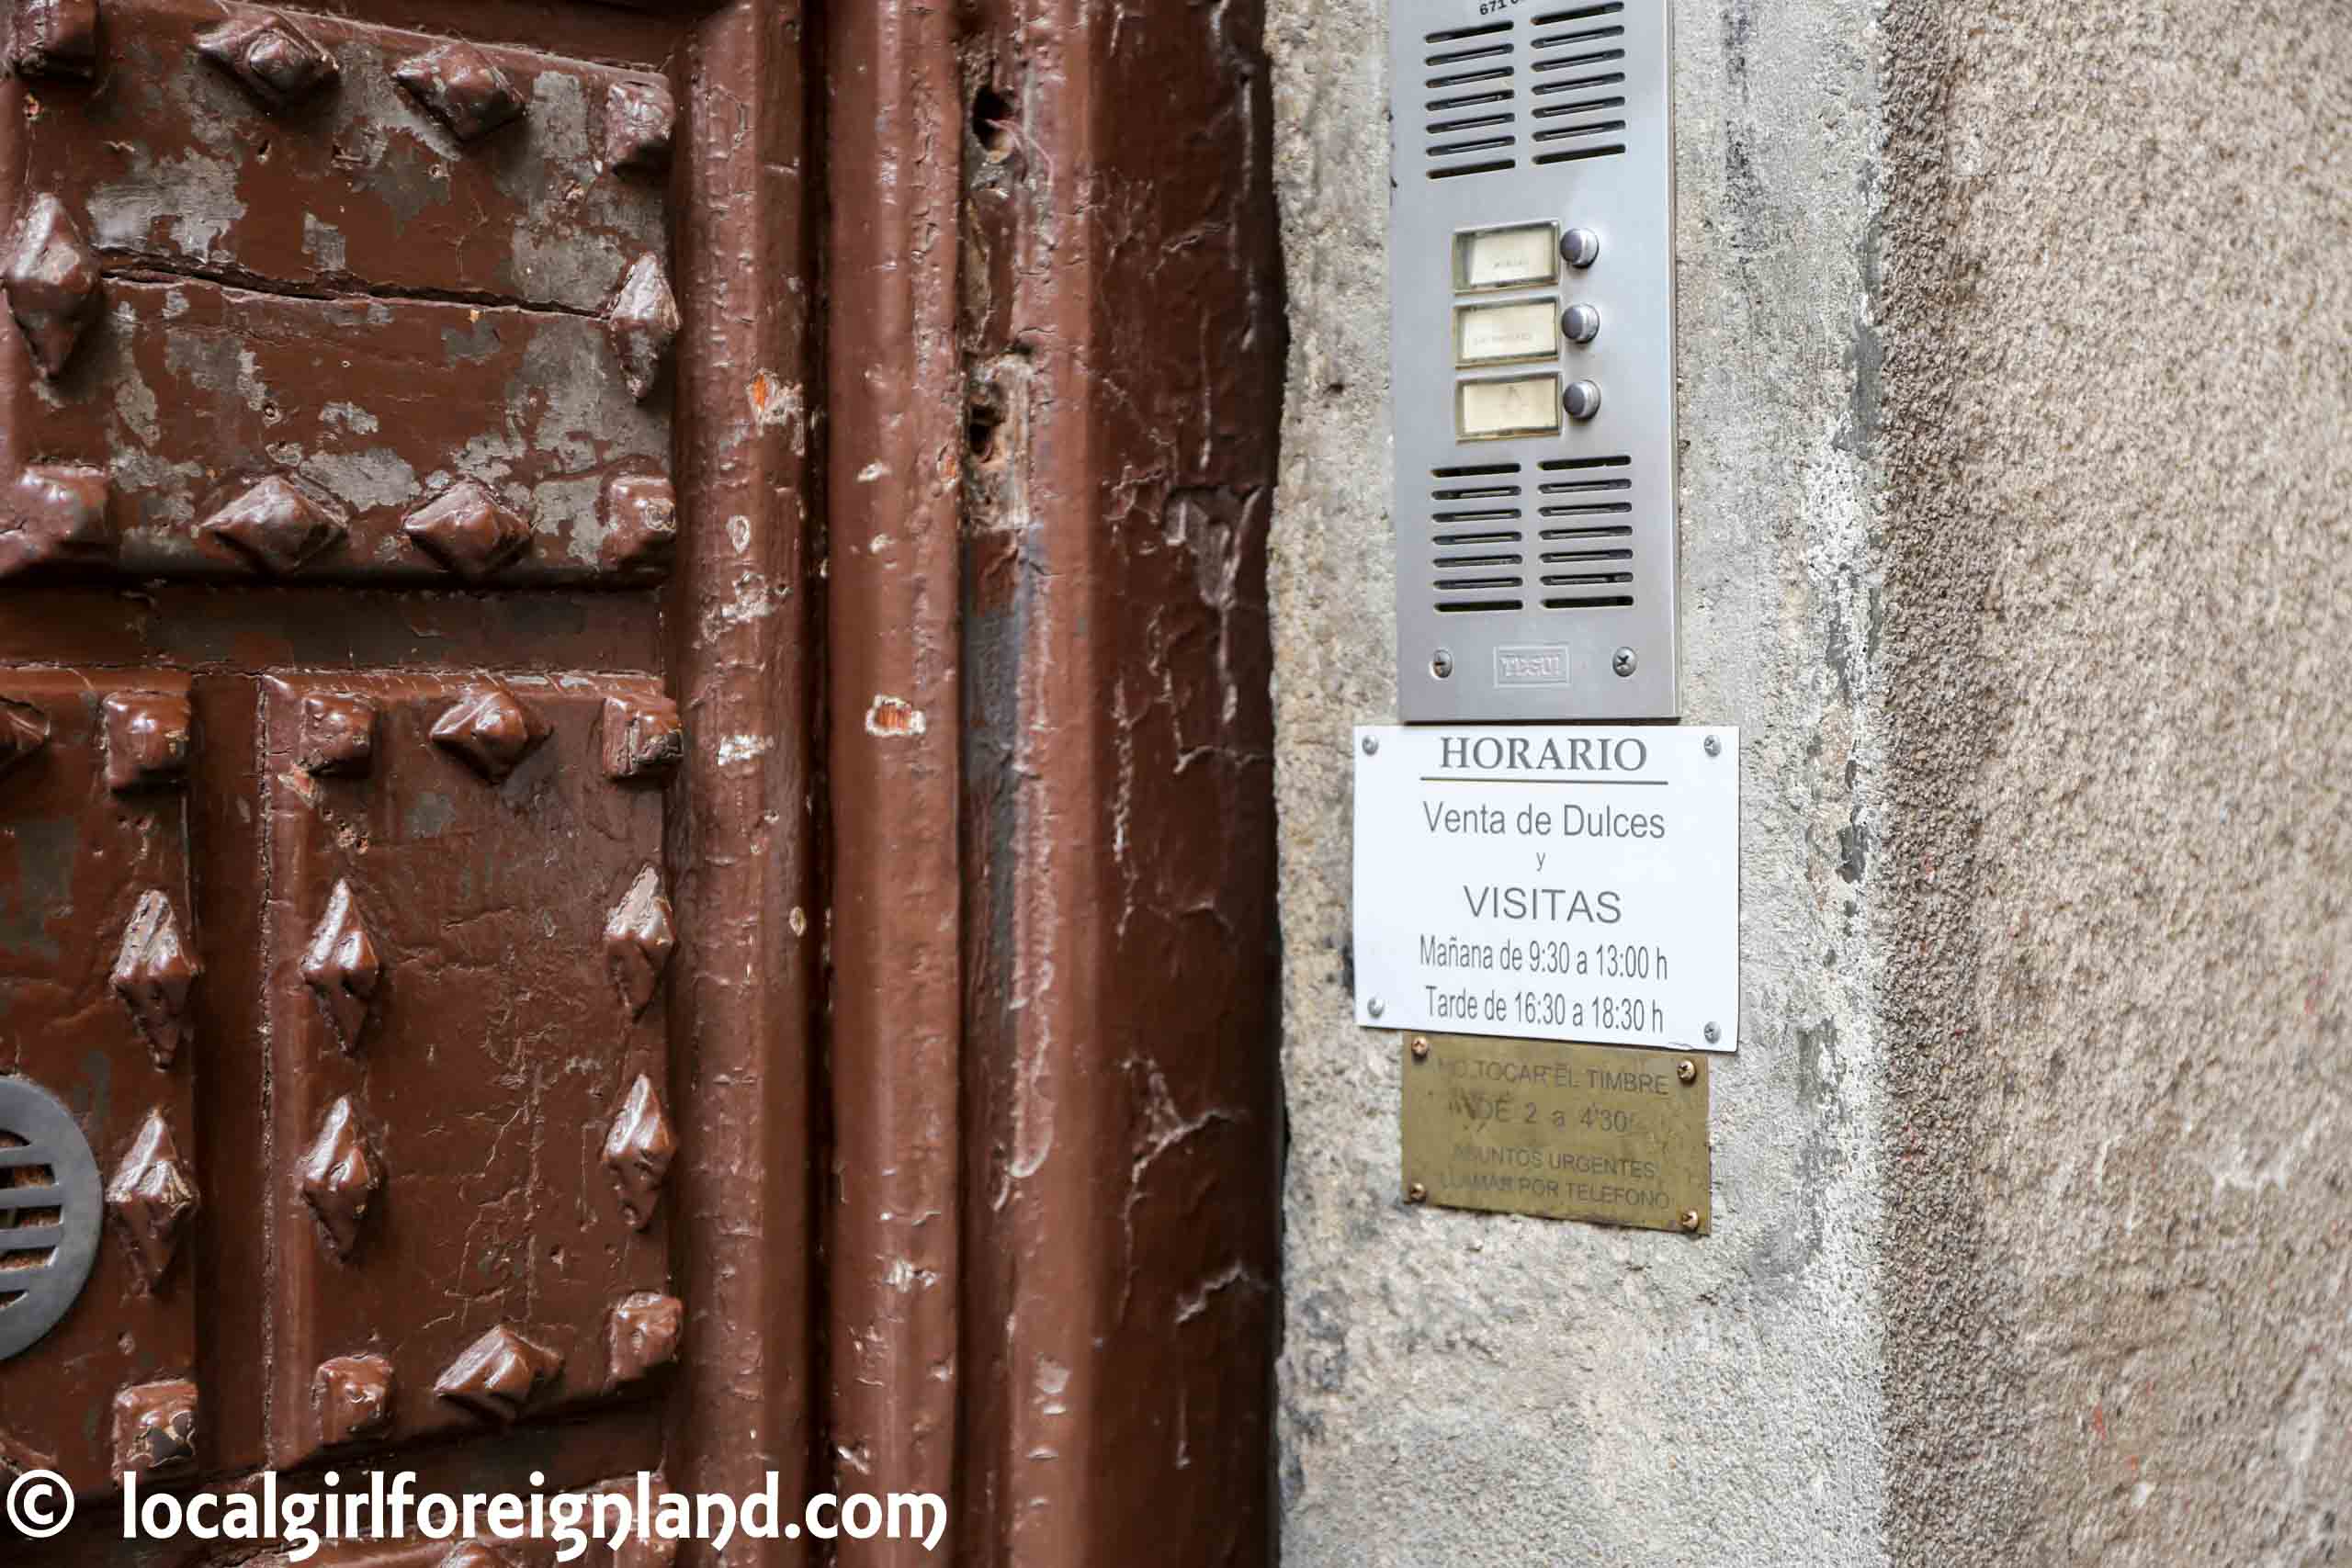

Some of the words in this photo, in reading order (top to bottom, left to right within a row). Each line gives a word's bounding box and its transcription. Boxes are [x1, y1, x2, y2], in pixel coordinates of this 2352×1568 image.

[1440, 736, 1647, 772] HORARIO
[1423, 800, 1506, 835] Venta
[1516, 803, 1552, 836] de
[1563, 804, 1666, 840] Dulces
[1535, 852, 1546, 872] y
[1463, 885, 1623, 924] VISITAS
[1419, 934, 1494, 969] Mañana
[1499, 938, 1522, 971] de
[1529, 940, 1570, 974] 9:30
[1577, 950, 1588, 975] a
[1596, 944, 1649, 978] 13:00
[1656, 946, 1668, 980] h
[1425, 985, 1478, 1020] Tarde
[1484, 989, 1507, 1021] de
[1515, 991, 1566, 1025] 16:30
[1572, 1001, 1583, 1026] a
[1591, 996, 1645, 1031] 18:30
[1652, 998, 1663, 1032] h
[1474, 1060, 1550, 1089] TOCAR
[1587, 1067, 1669, 1095] TIMBRE
[1524, 1101, 1537, 1124] 2
[1453, 1145, 1544, 1169] UNTOS
[1549, 1153, 1656, 1179] URGENTES
[1518, 1175, 1559, 1198] POR
[1566, 1182, 1670, 1210] TELEFONO
